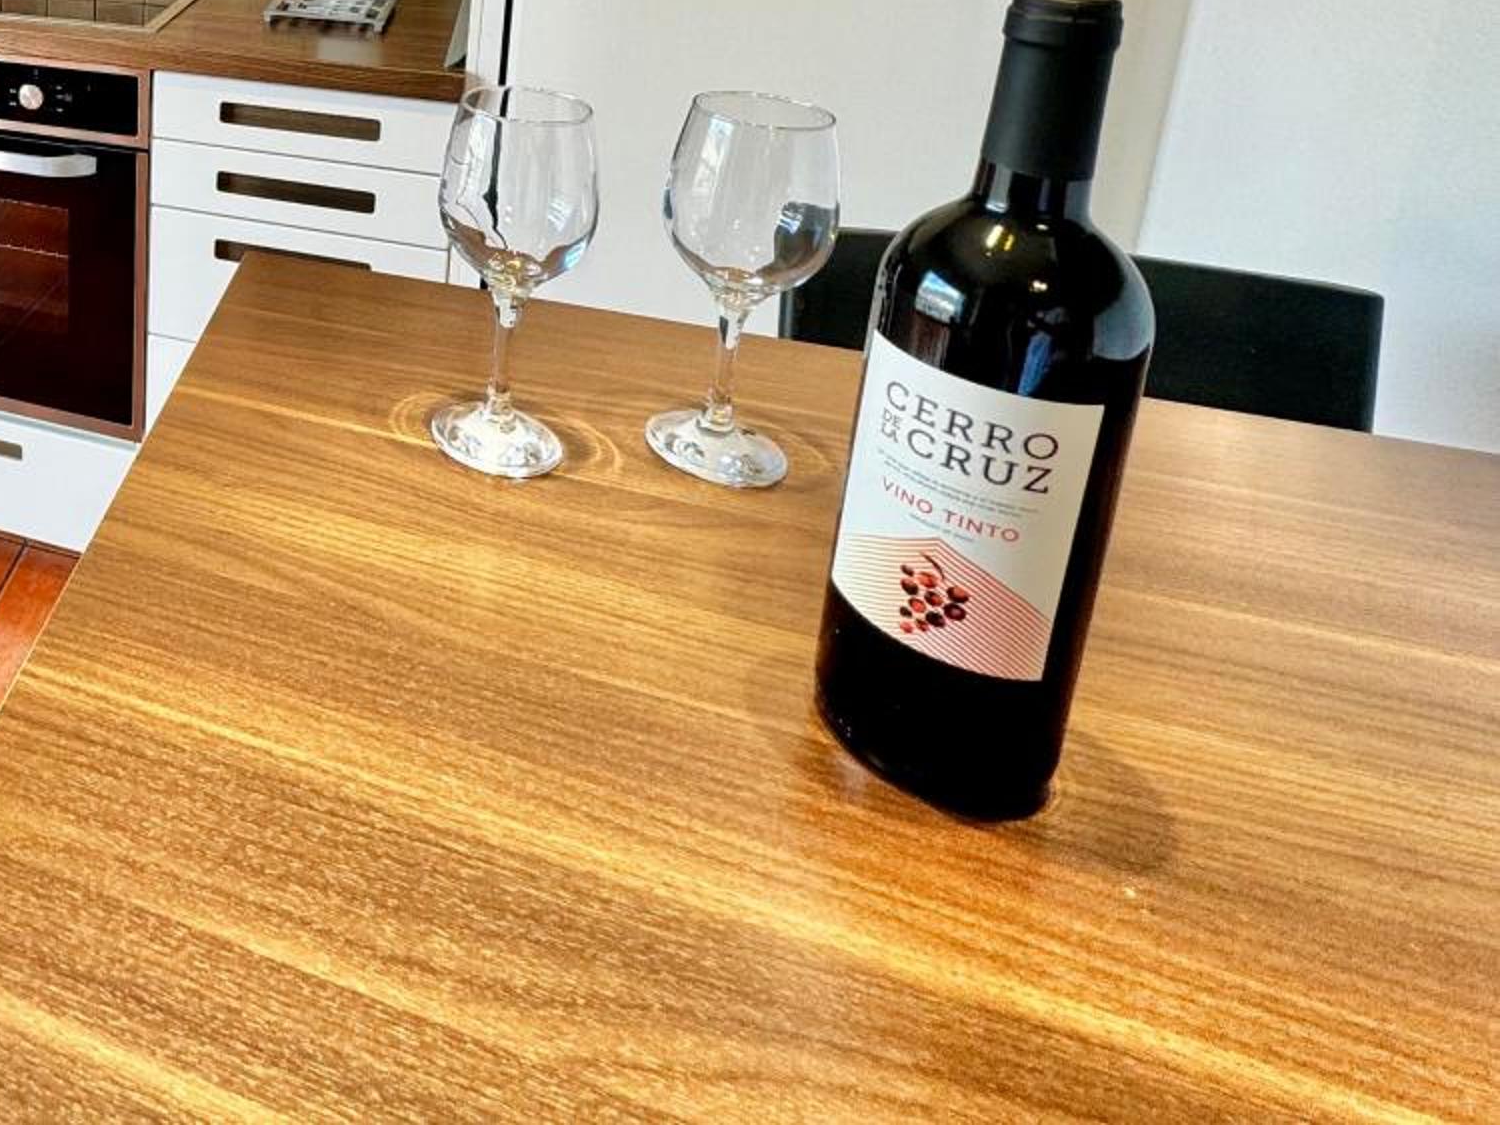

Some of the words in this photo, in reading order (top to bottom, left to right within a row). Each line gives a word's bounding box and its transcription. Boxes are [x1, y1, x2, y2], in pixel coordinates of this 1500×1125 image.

[881, 421, 899, 443] LA
[882, 407, 902, 430] DE
[886, 381, 1059, 460] CERRO
[906, 428, 1053, 494] CRUZ
[882, 475, 933, 514] VINO
[943, 508, 1020, 543] TINTO
